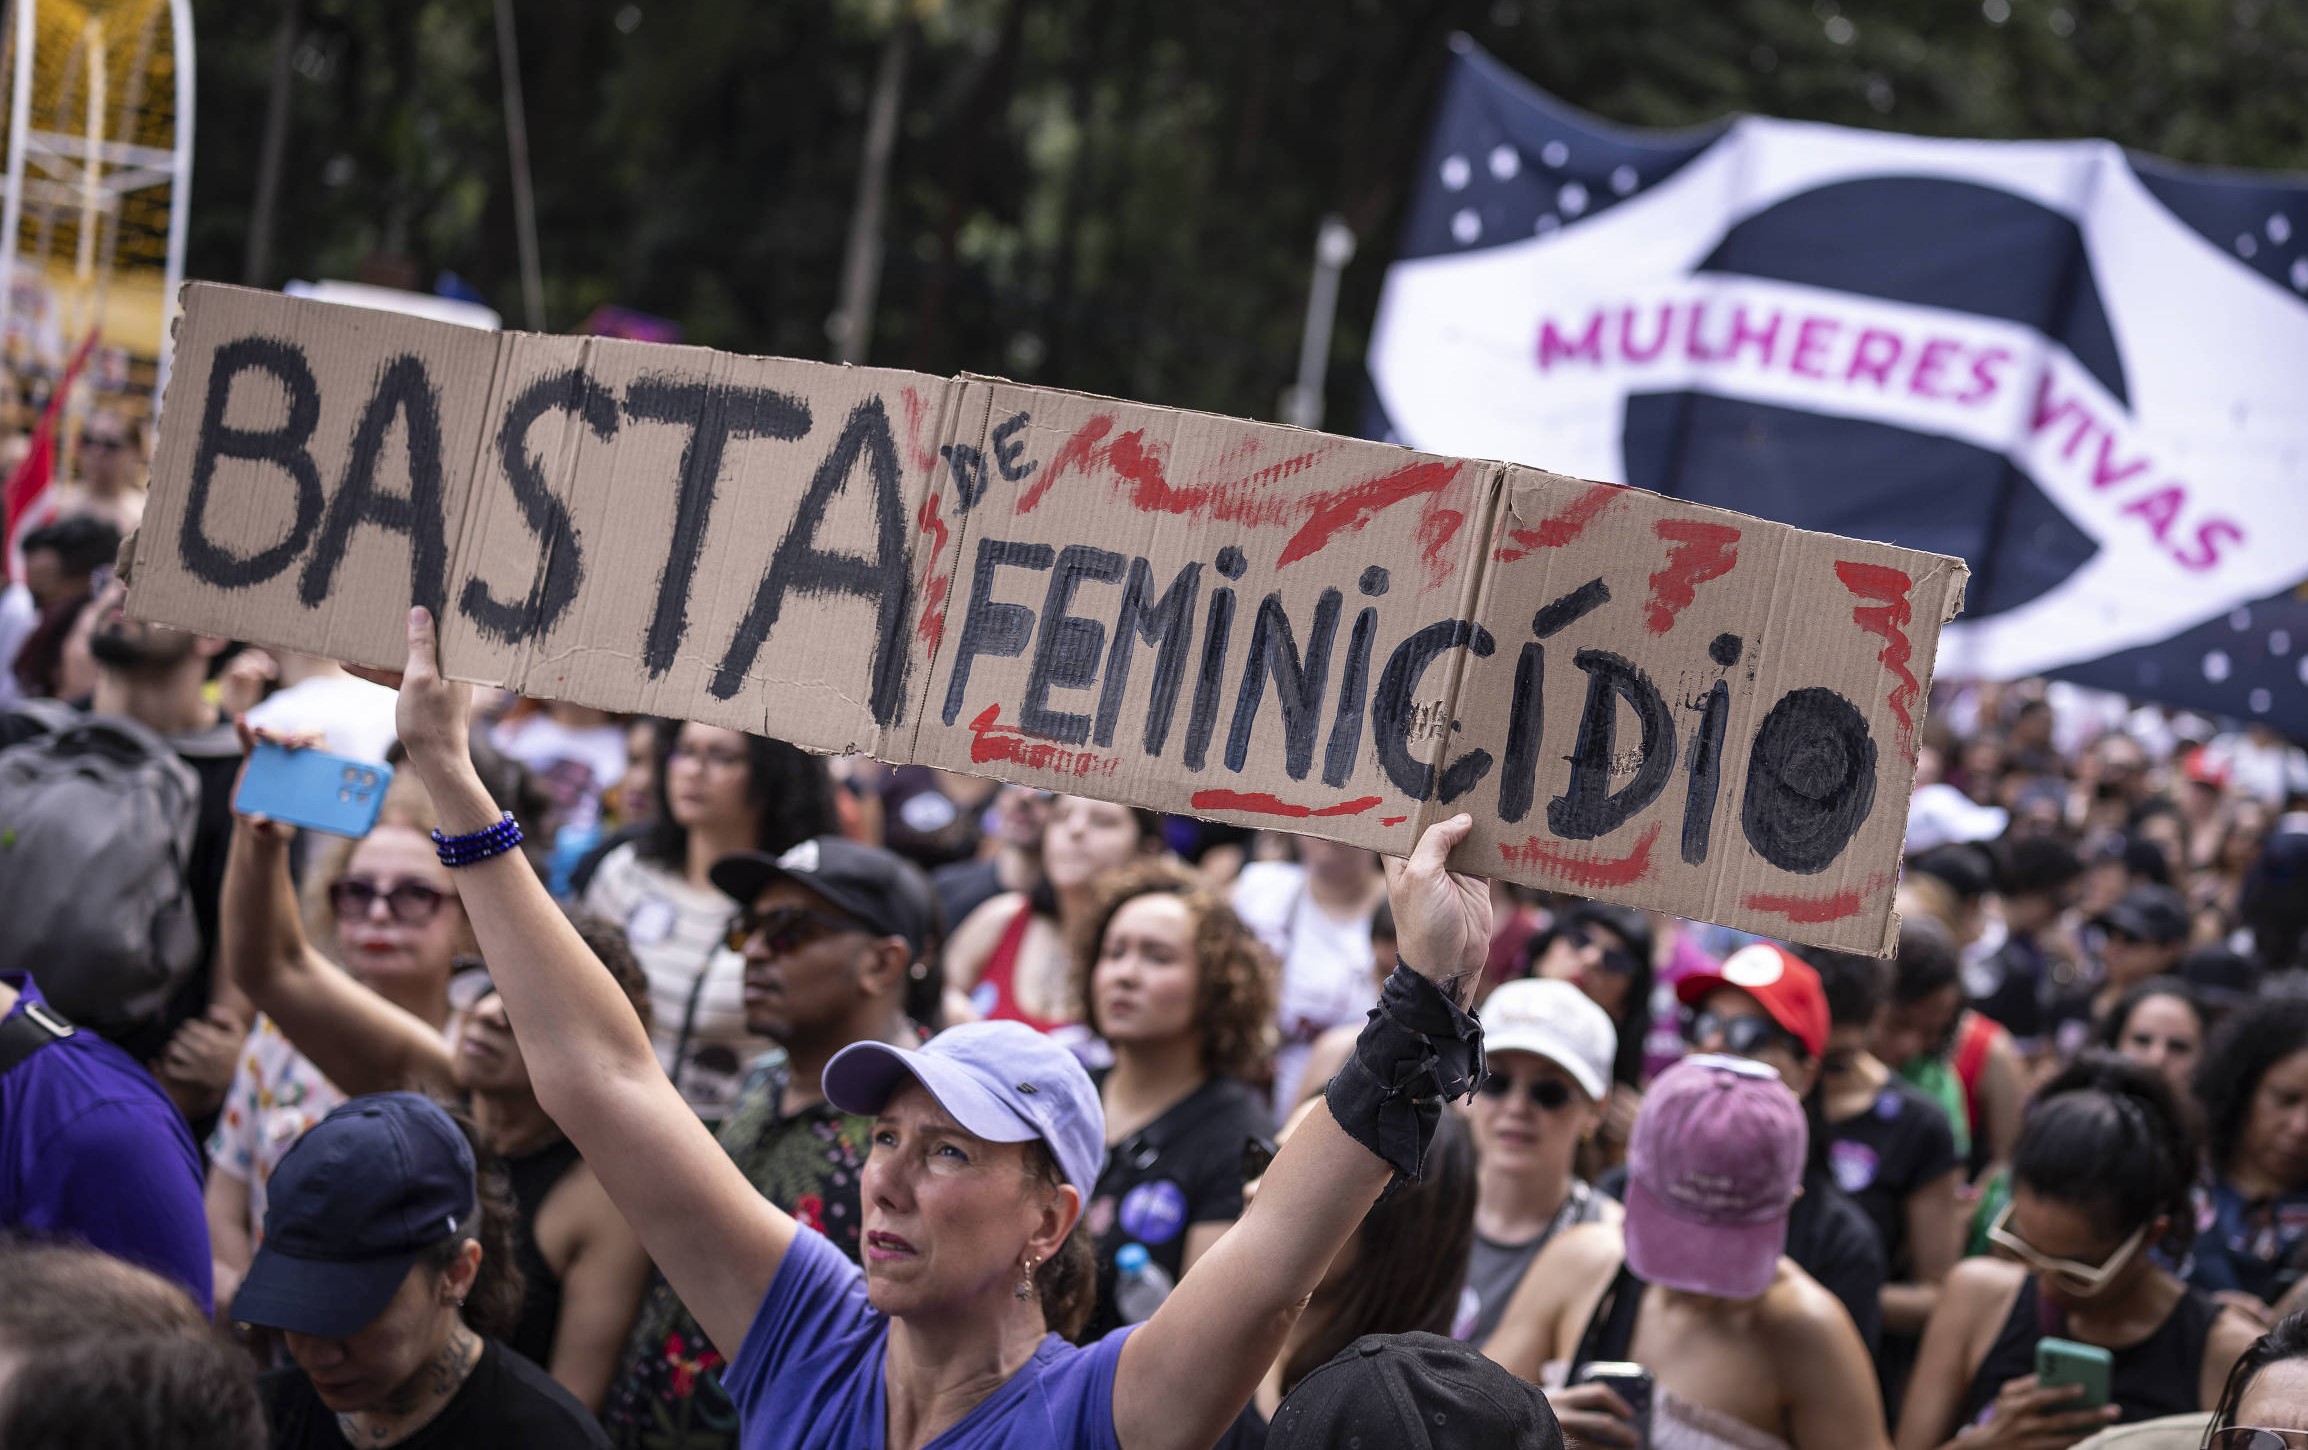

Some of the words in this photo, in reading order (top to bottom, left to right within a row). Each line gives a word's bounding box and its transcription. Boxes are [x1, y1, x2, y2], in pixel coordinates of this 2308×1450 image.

[179, 333, 915, 729] BASTA
[940, 411, 1038, 517] DE
[1538, 300, 2017, 403] MULHERES
[2028, 369, 2244, 572] VIVAS
